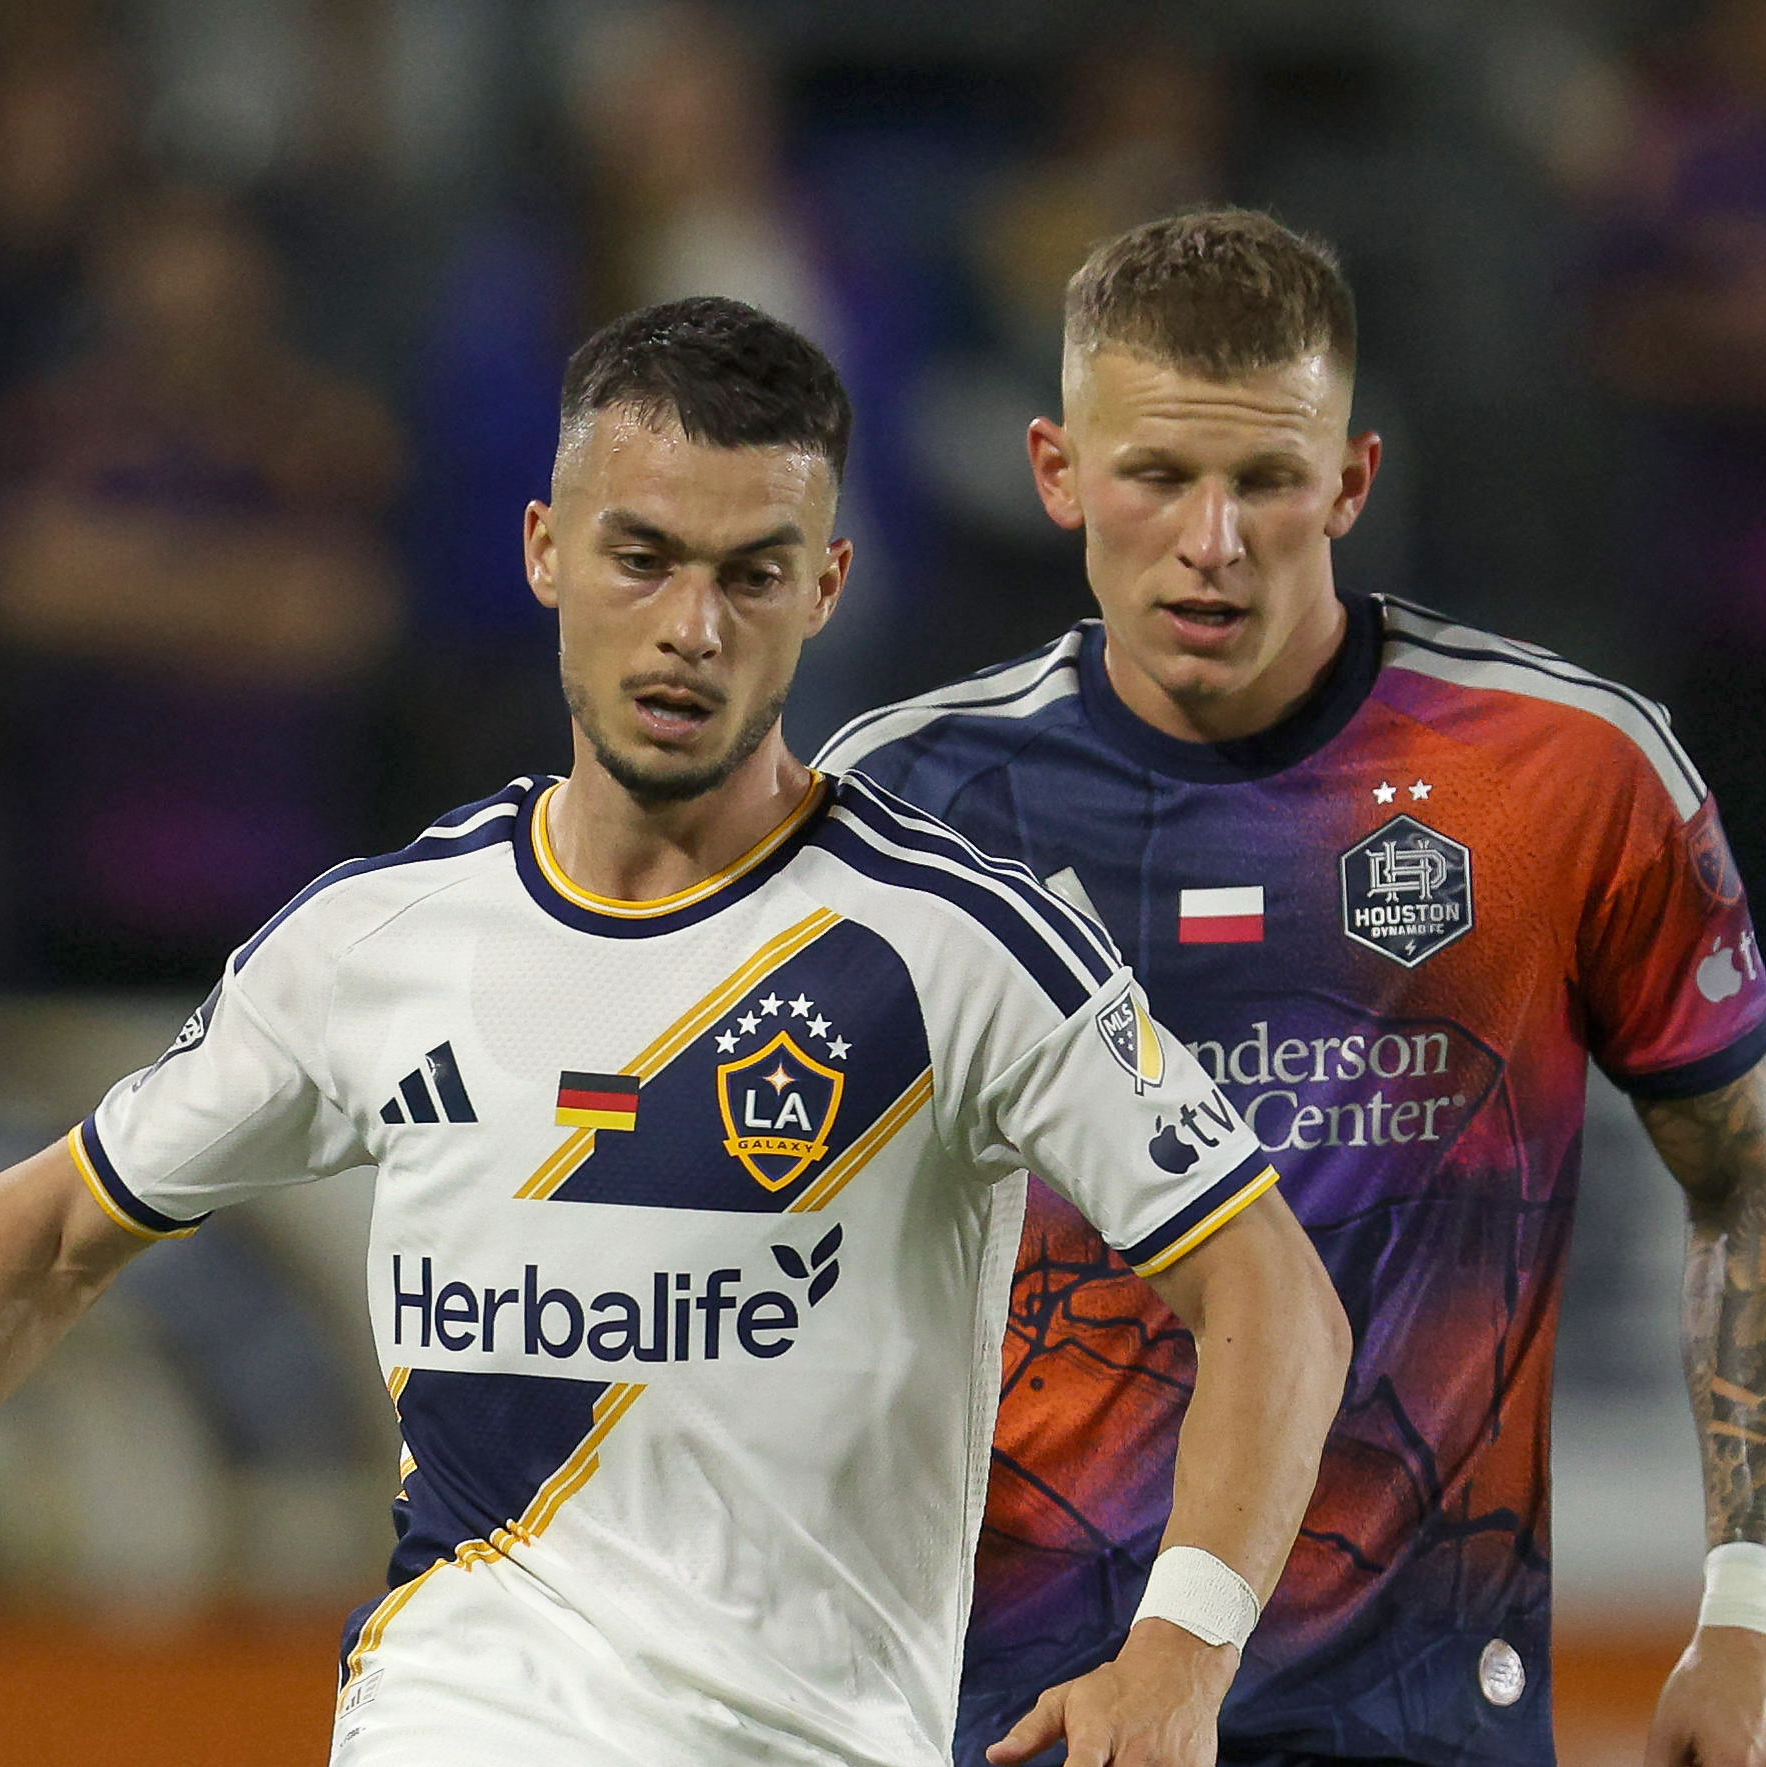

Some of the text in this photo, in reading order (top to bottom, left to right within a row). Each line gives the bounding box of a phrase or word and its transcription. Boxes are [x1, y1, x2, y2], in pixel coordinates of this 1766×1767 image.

[1354, 902, 1460, 928] HOUSTON
[1370, 924, 1427, 938] DYNAMO
[1102, 1003, 1134, 1037] MLS
[1186, 1020, 1450, 1085] nderson
[744, 1089, 813, 1132] LA
[1179, 1088, 1235, 1148] tv
[1244, 1089, 1450, 1152] Center
[737, 1138, 815, 1154] GALAXY
[392, 1254, 800, 1363] Herbalife
